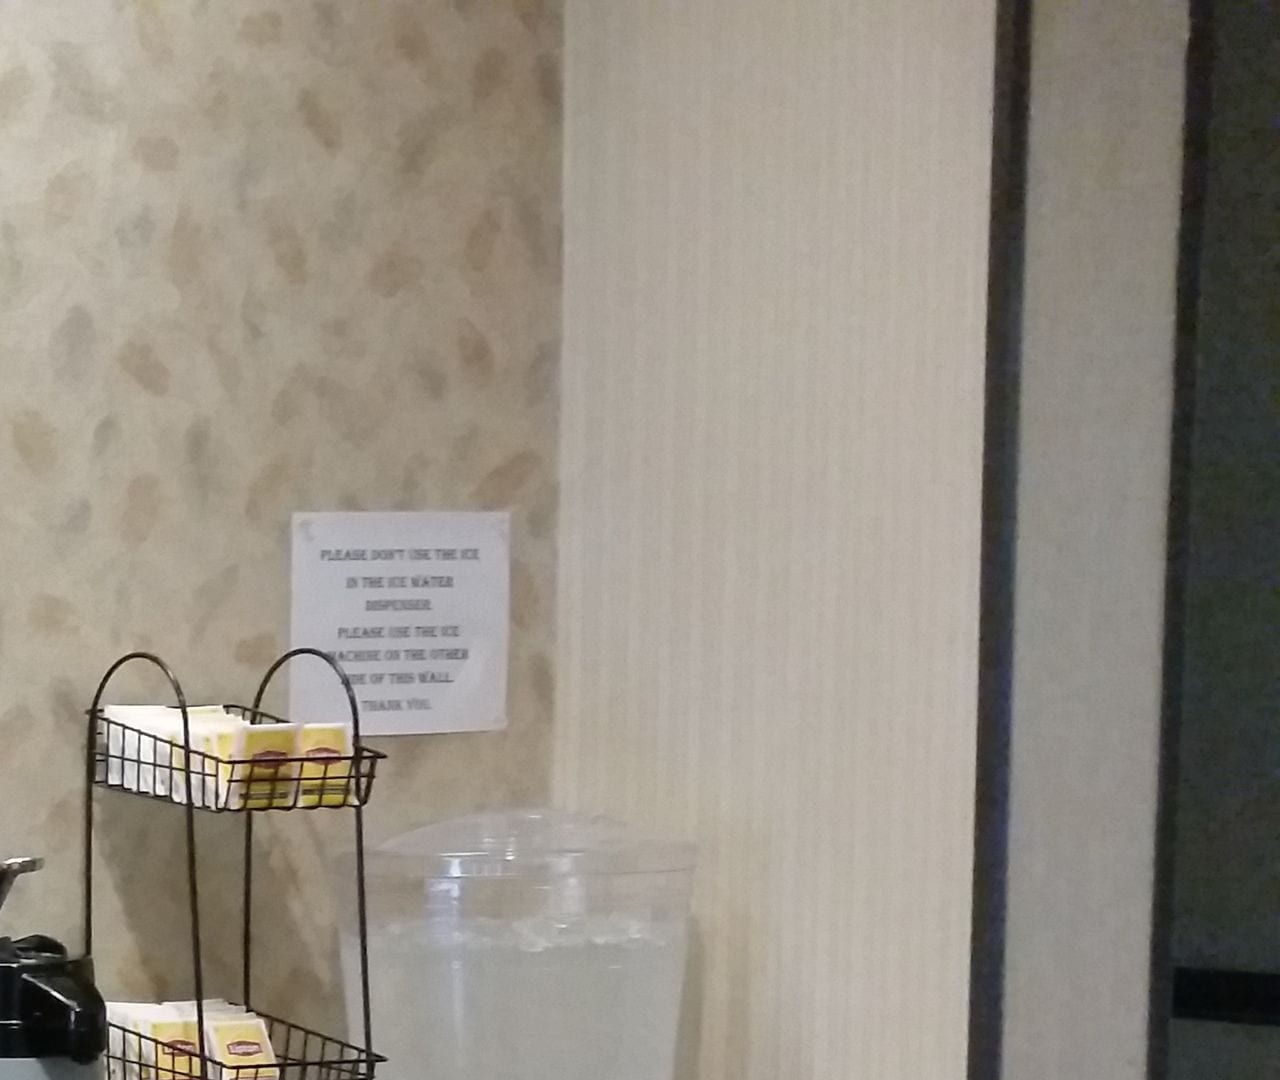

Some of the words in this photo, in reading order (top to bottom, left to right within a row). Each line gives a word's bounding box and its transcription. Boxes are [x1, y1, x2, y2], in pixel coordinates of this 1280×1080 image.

[320, 549, 367, 561] PLEASE
[362, 577, 384, 588] THE
[411, 576, 454, 588] WATER
[338, 627, 384, 639] PLEASE
[341, 674, 366, 685] IDE
